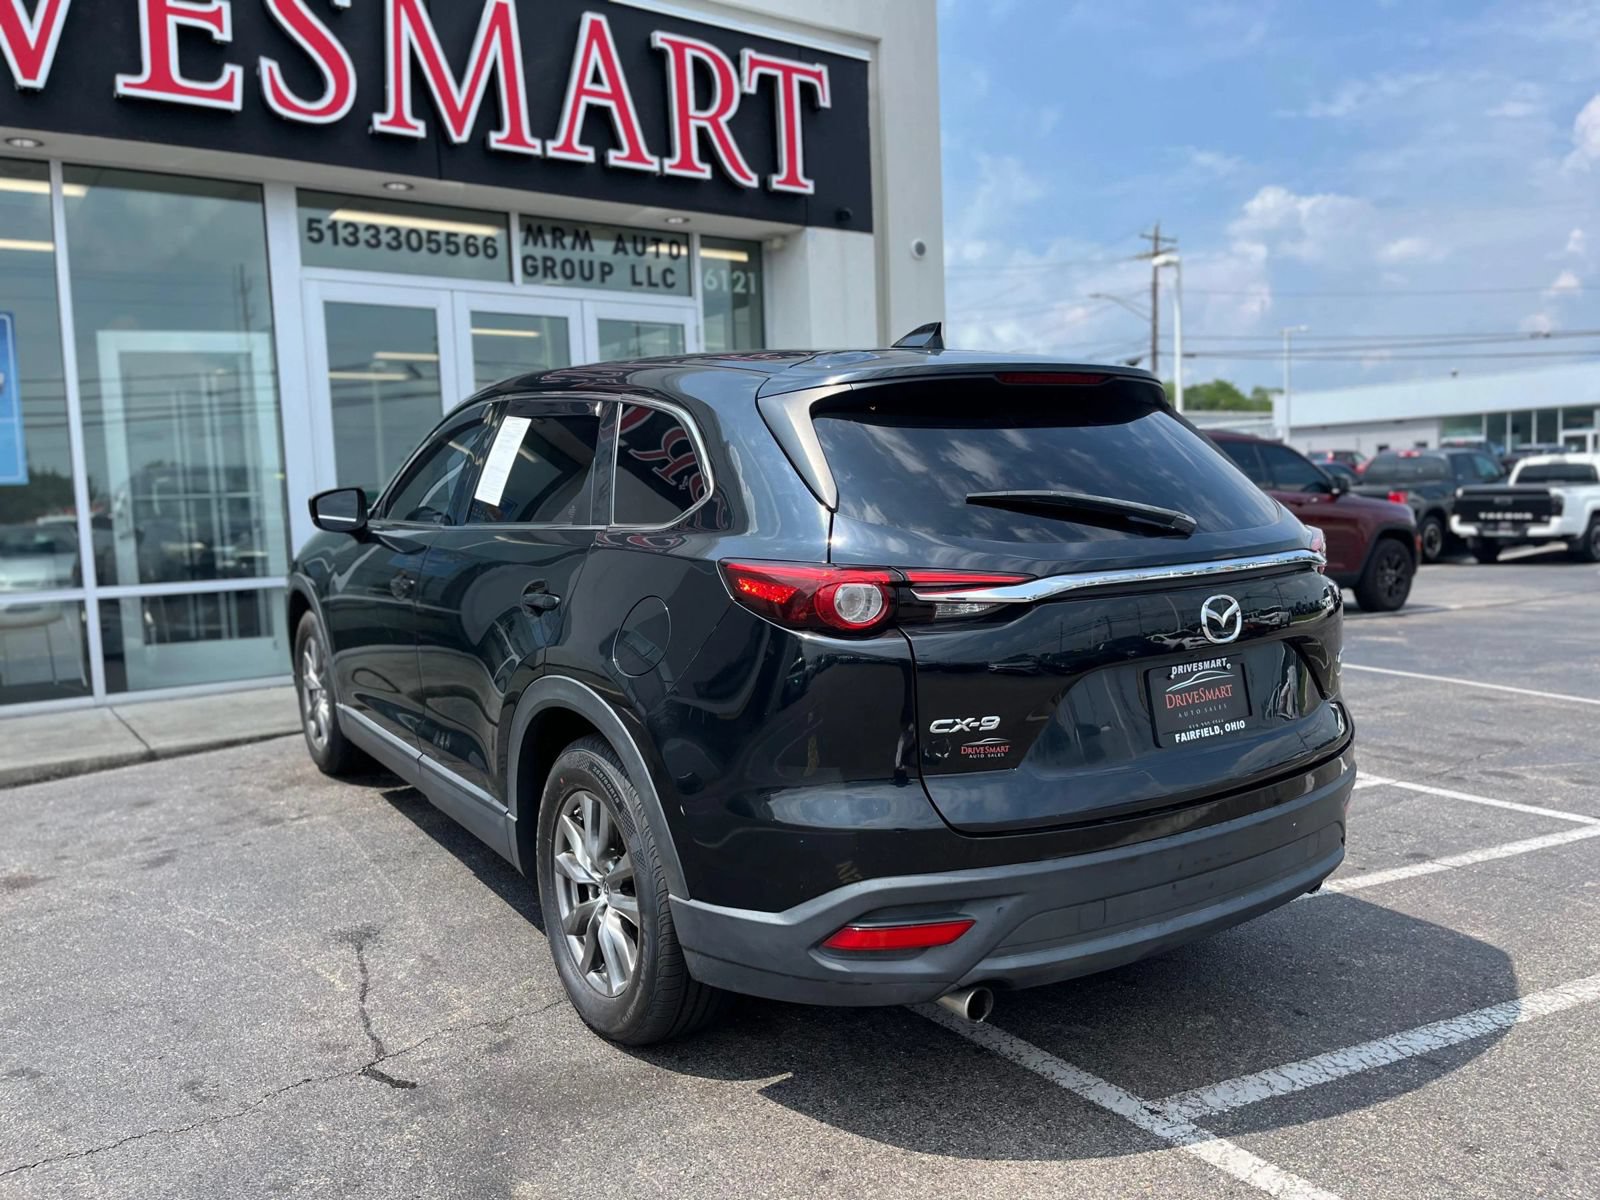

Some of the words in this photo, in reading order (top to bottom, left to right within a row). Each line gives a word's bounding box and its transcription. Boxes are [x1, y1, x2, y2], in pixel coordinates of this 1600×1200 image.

[306, 217, 499, 260] 5133305566
[523, 223, 594, 252] MRM
[612, 233, 682, 260] AUTO
[521, 254, 614, 283] GROUP
[631, 264, 677, 289] LLC
[703, 267, 756, 295] 6121
[1171, 658, 1227, 675] DRIVESMART
[929, 715, 1001, 734] CX-9
[1175, 725, 1223, 743] FAIRFIELD,
[1224, 720, 1246, 732] OHIO
